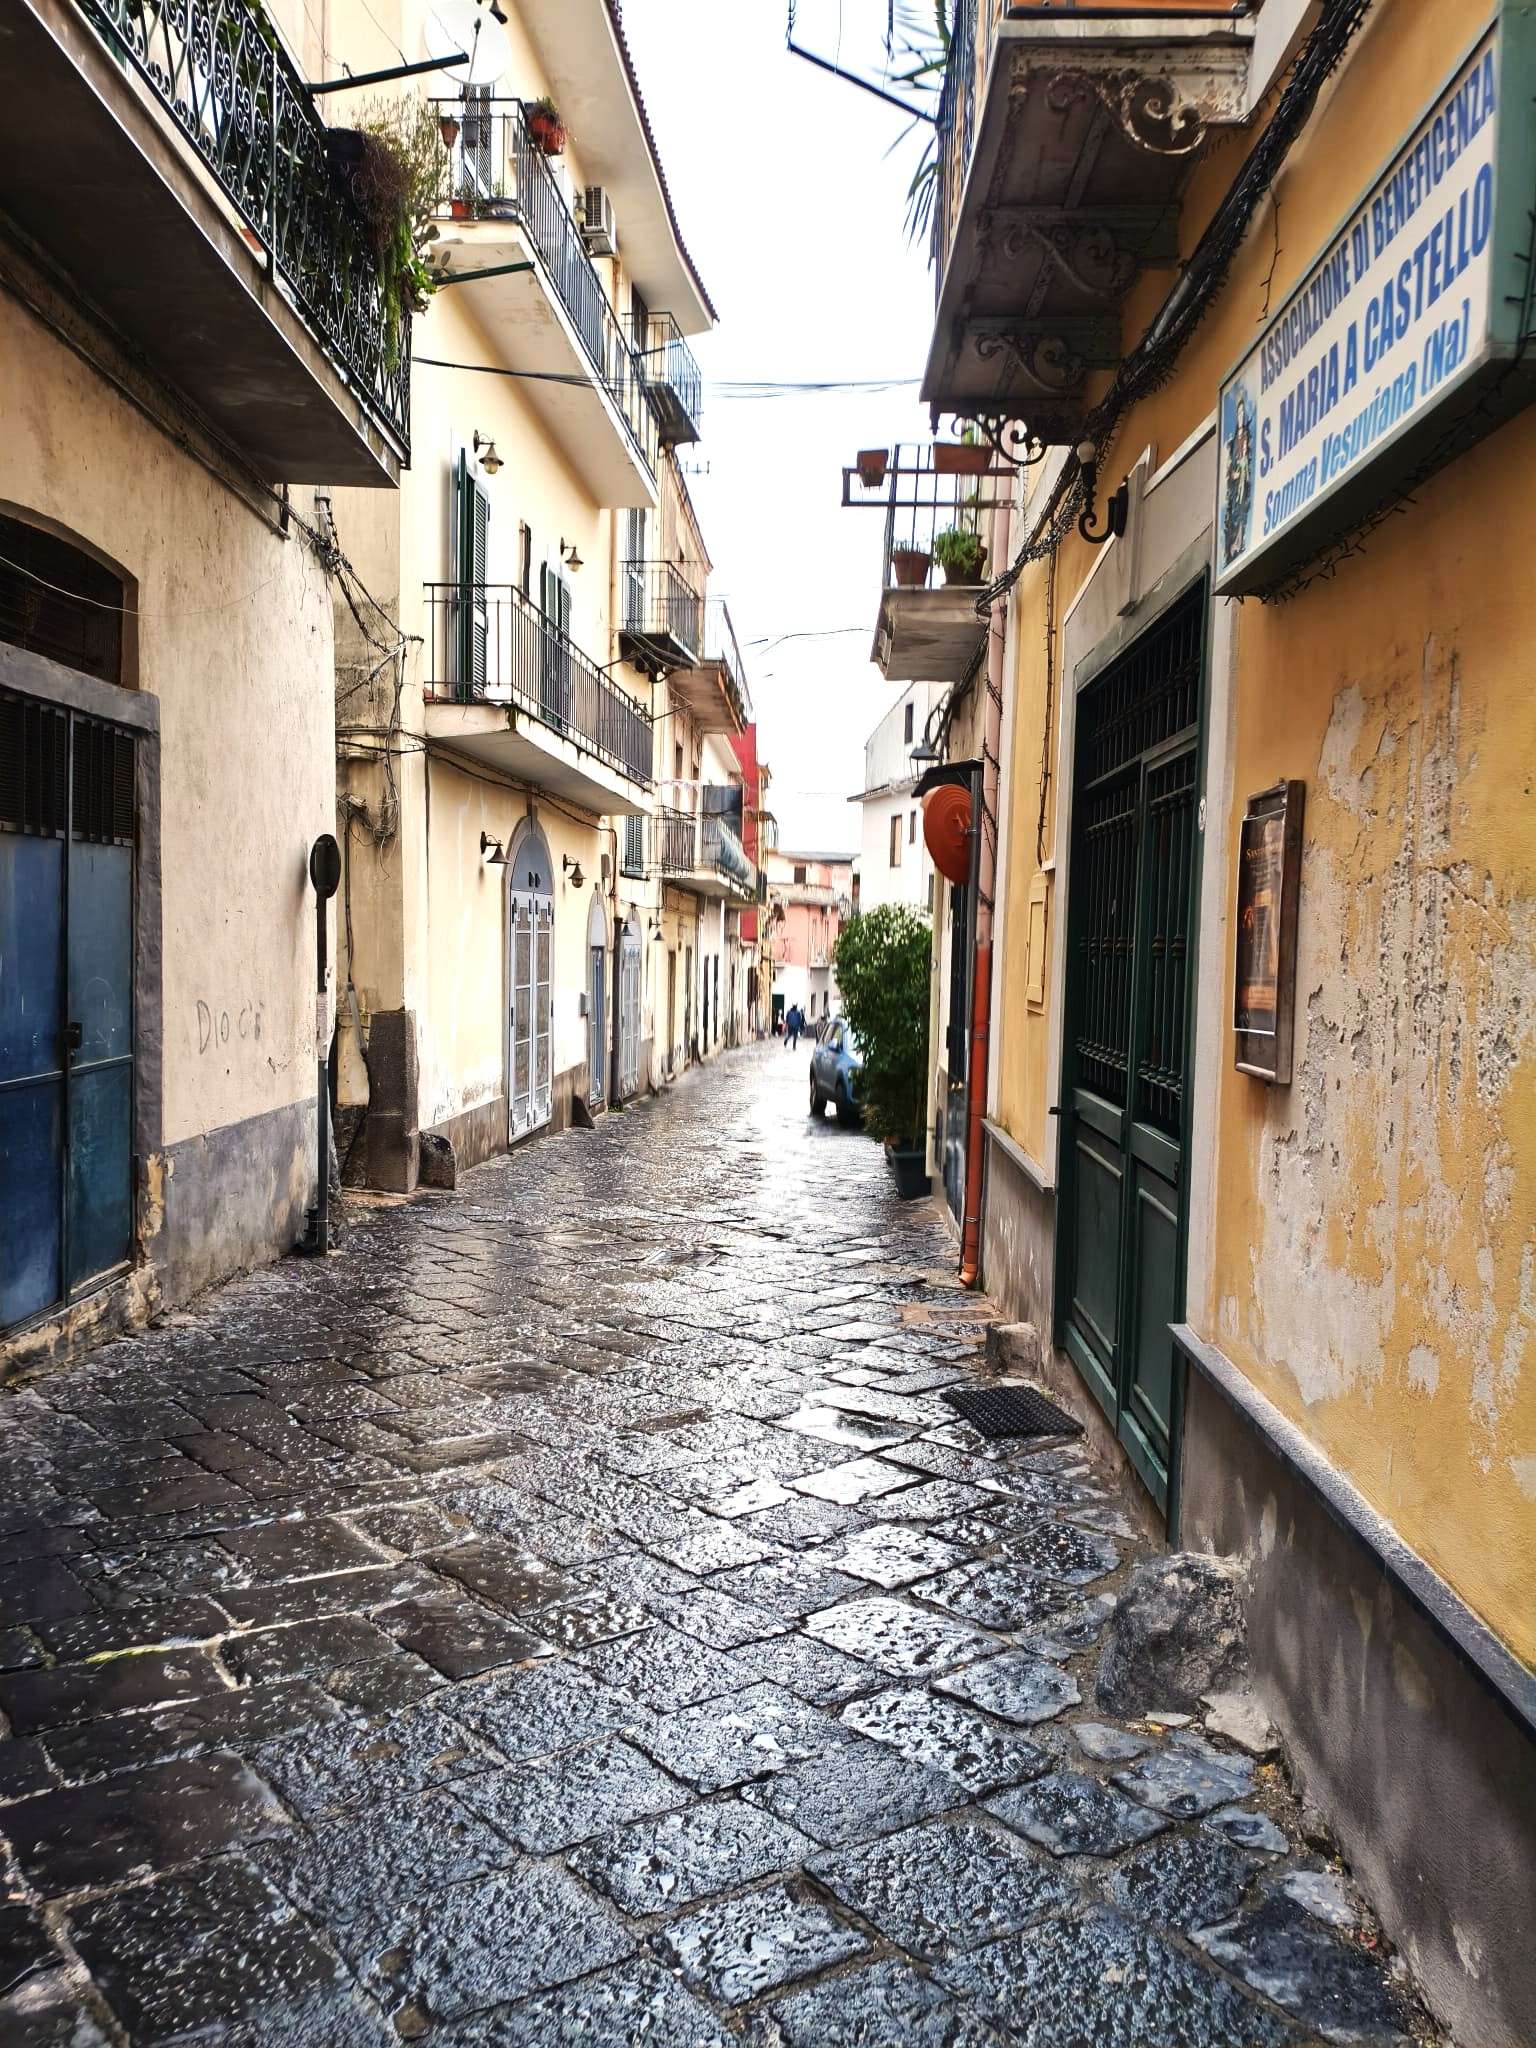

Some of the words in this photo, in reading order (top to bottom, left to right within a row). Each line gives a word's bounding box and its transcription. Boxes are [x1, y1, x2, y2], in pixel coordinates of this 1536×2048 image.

[1260, 416, 1274, 478] S.
[1278, 341, 1339, 463] MARIA
[1343, 320, 1358, 398] A
[1364, 162, 1492, 374] CASTELLO
[1261, 238, 1350, 395] ASSOCIAZIONE
[1352, 213, 1370, 285] DI
[1372, 48, 1495, 261] BENEFICENZA
[1264, 456, 1318, 537] Somma
[1320, 360, 1417, 488] Vesuviana
